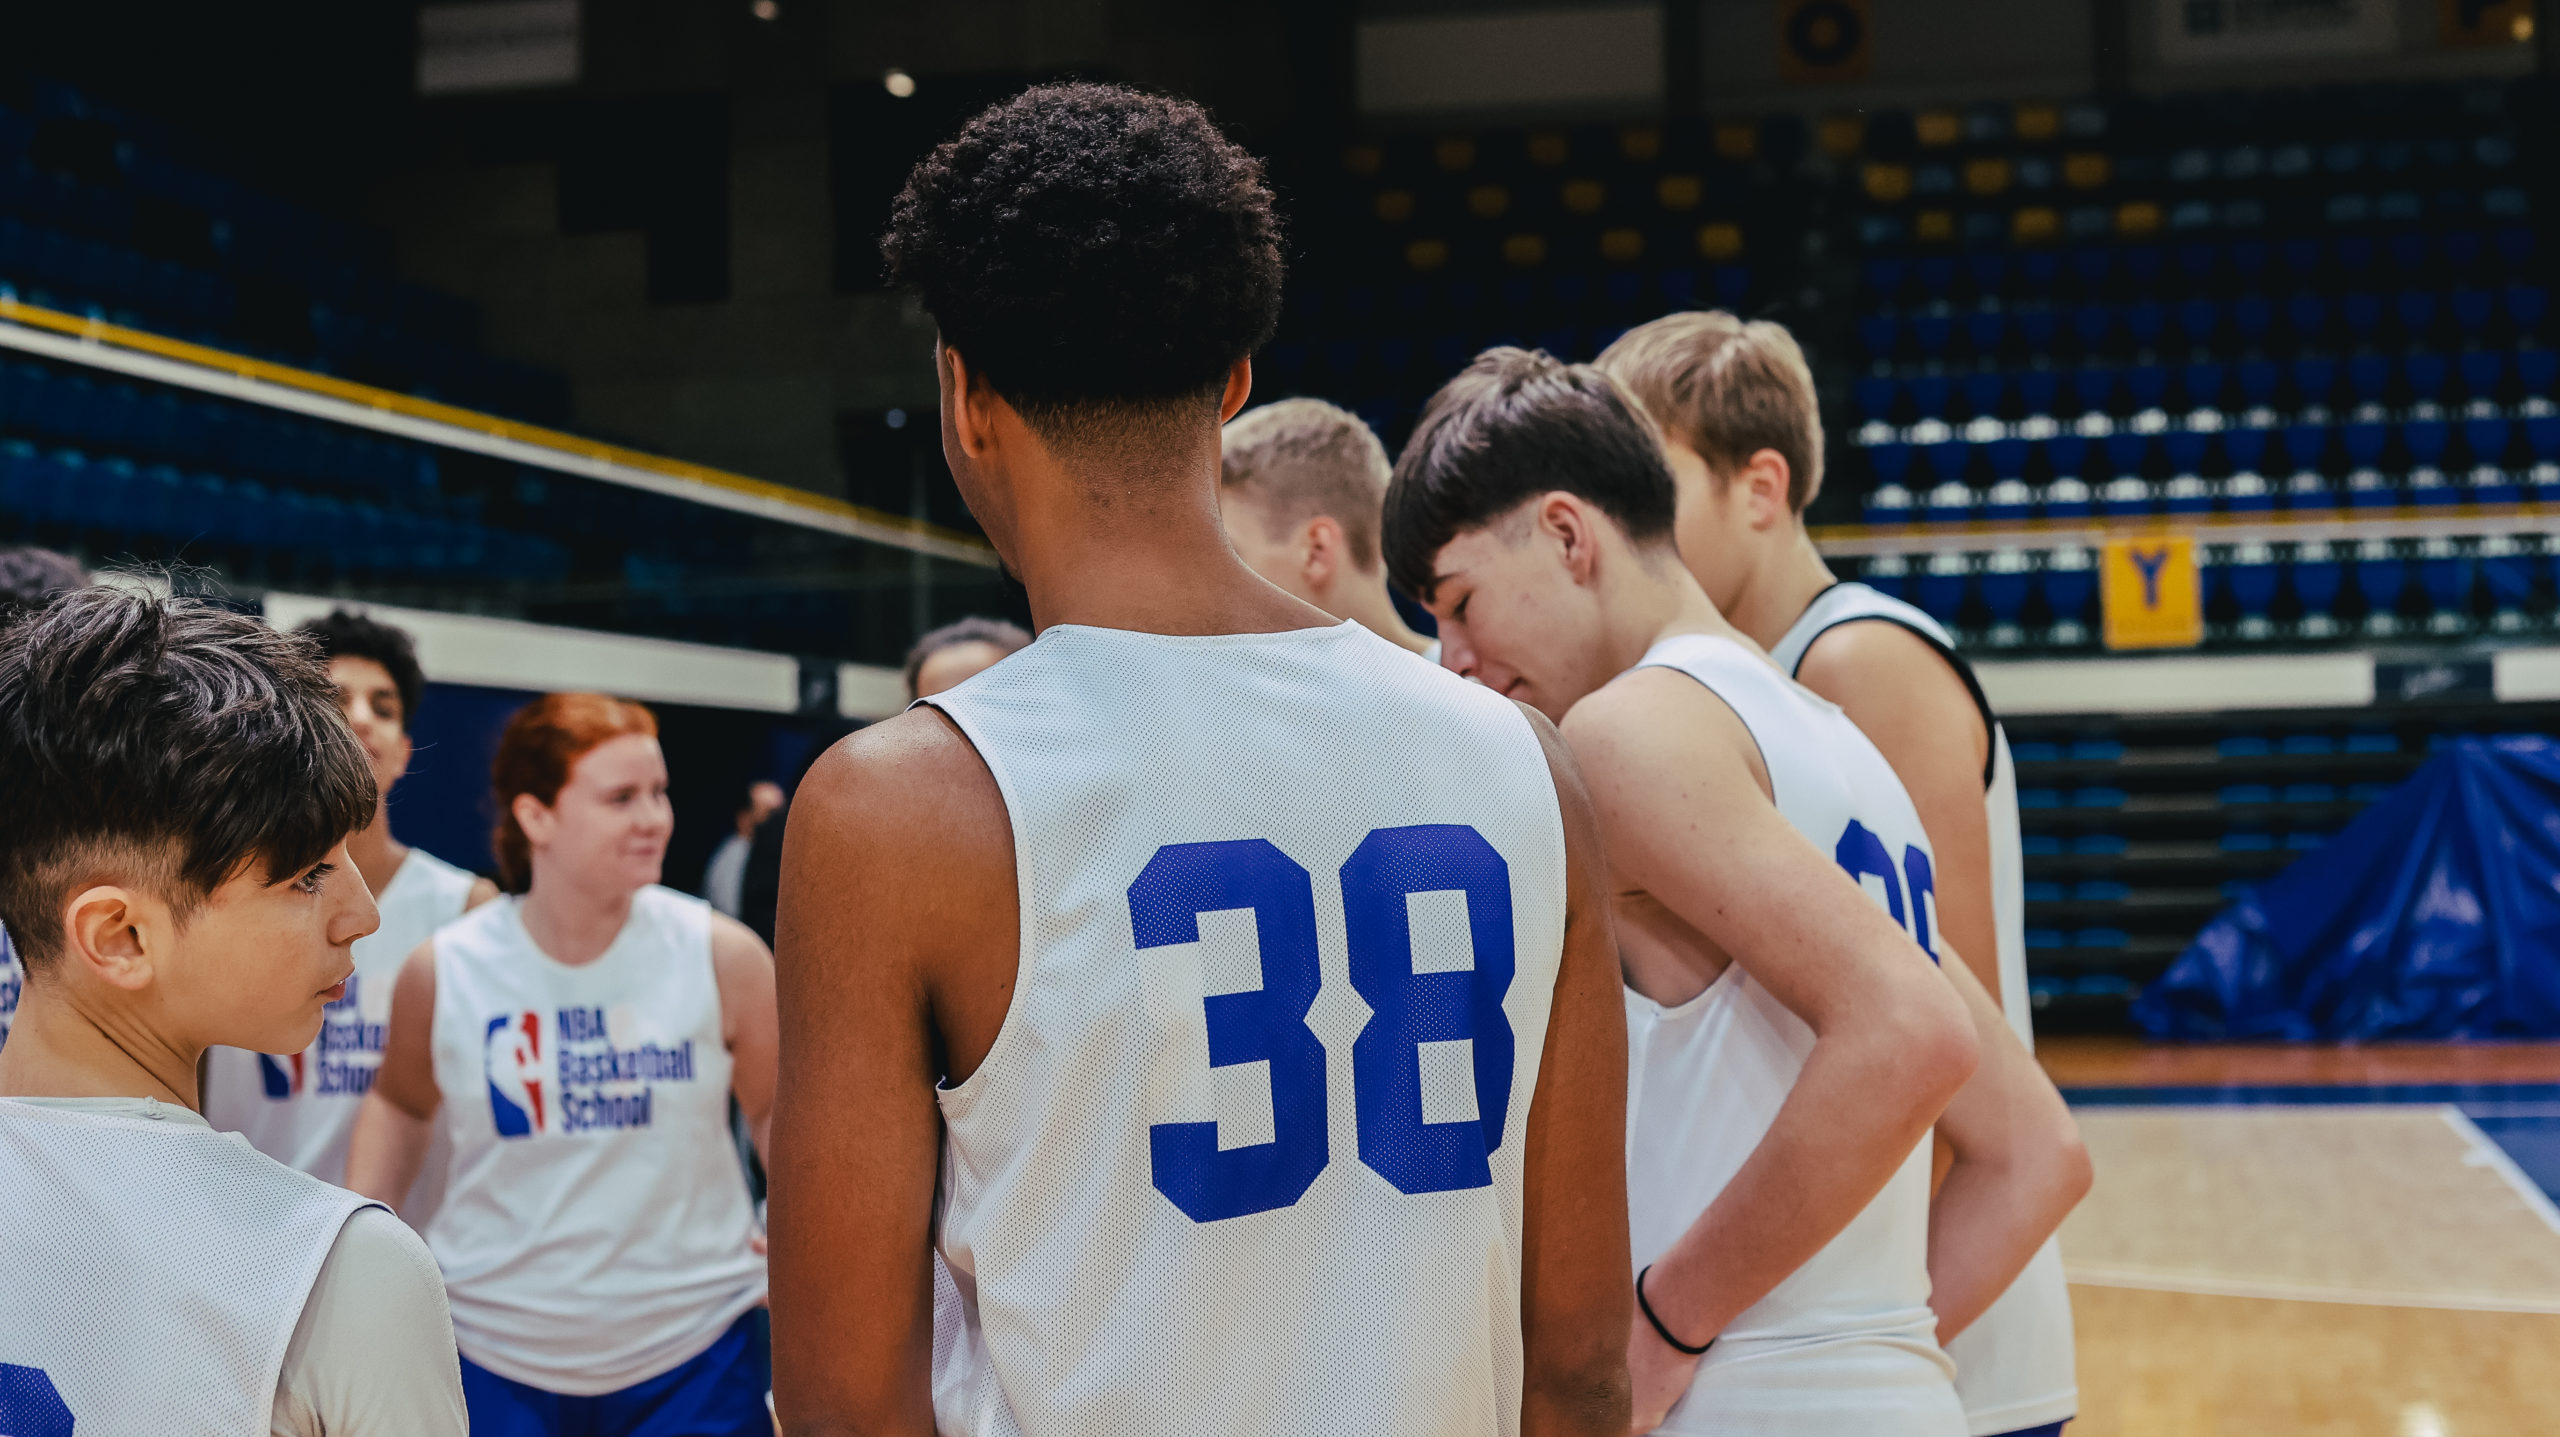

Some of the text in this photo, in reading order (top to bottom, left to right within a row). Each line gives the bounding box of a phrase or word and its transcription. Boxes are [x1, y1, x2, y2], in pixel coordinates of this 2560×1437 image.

[2130, 547, 2170, 609] Y
[557, 1007, 606, 1041] NBA
[1127, 824, 1515, 1224] 38
[558, 1039, 694, 1086] Basketball
[561, 1087, 651, 1132] School
